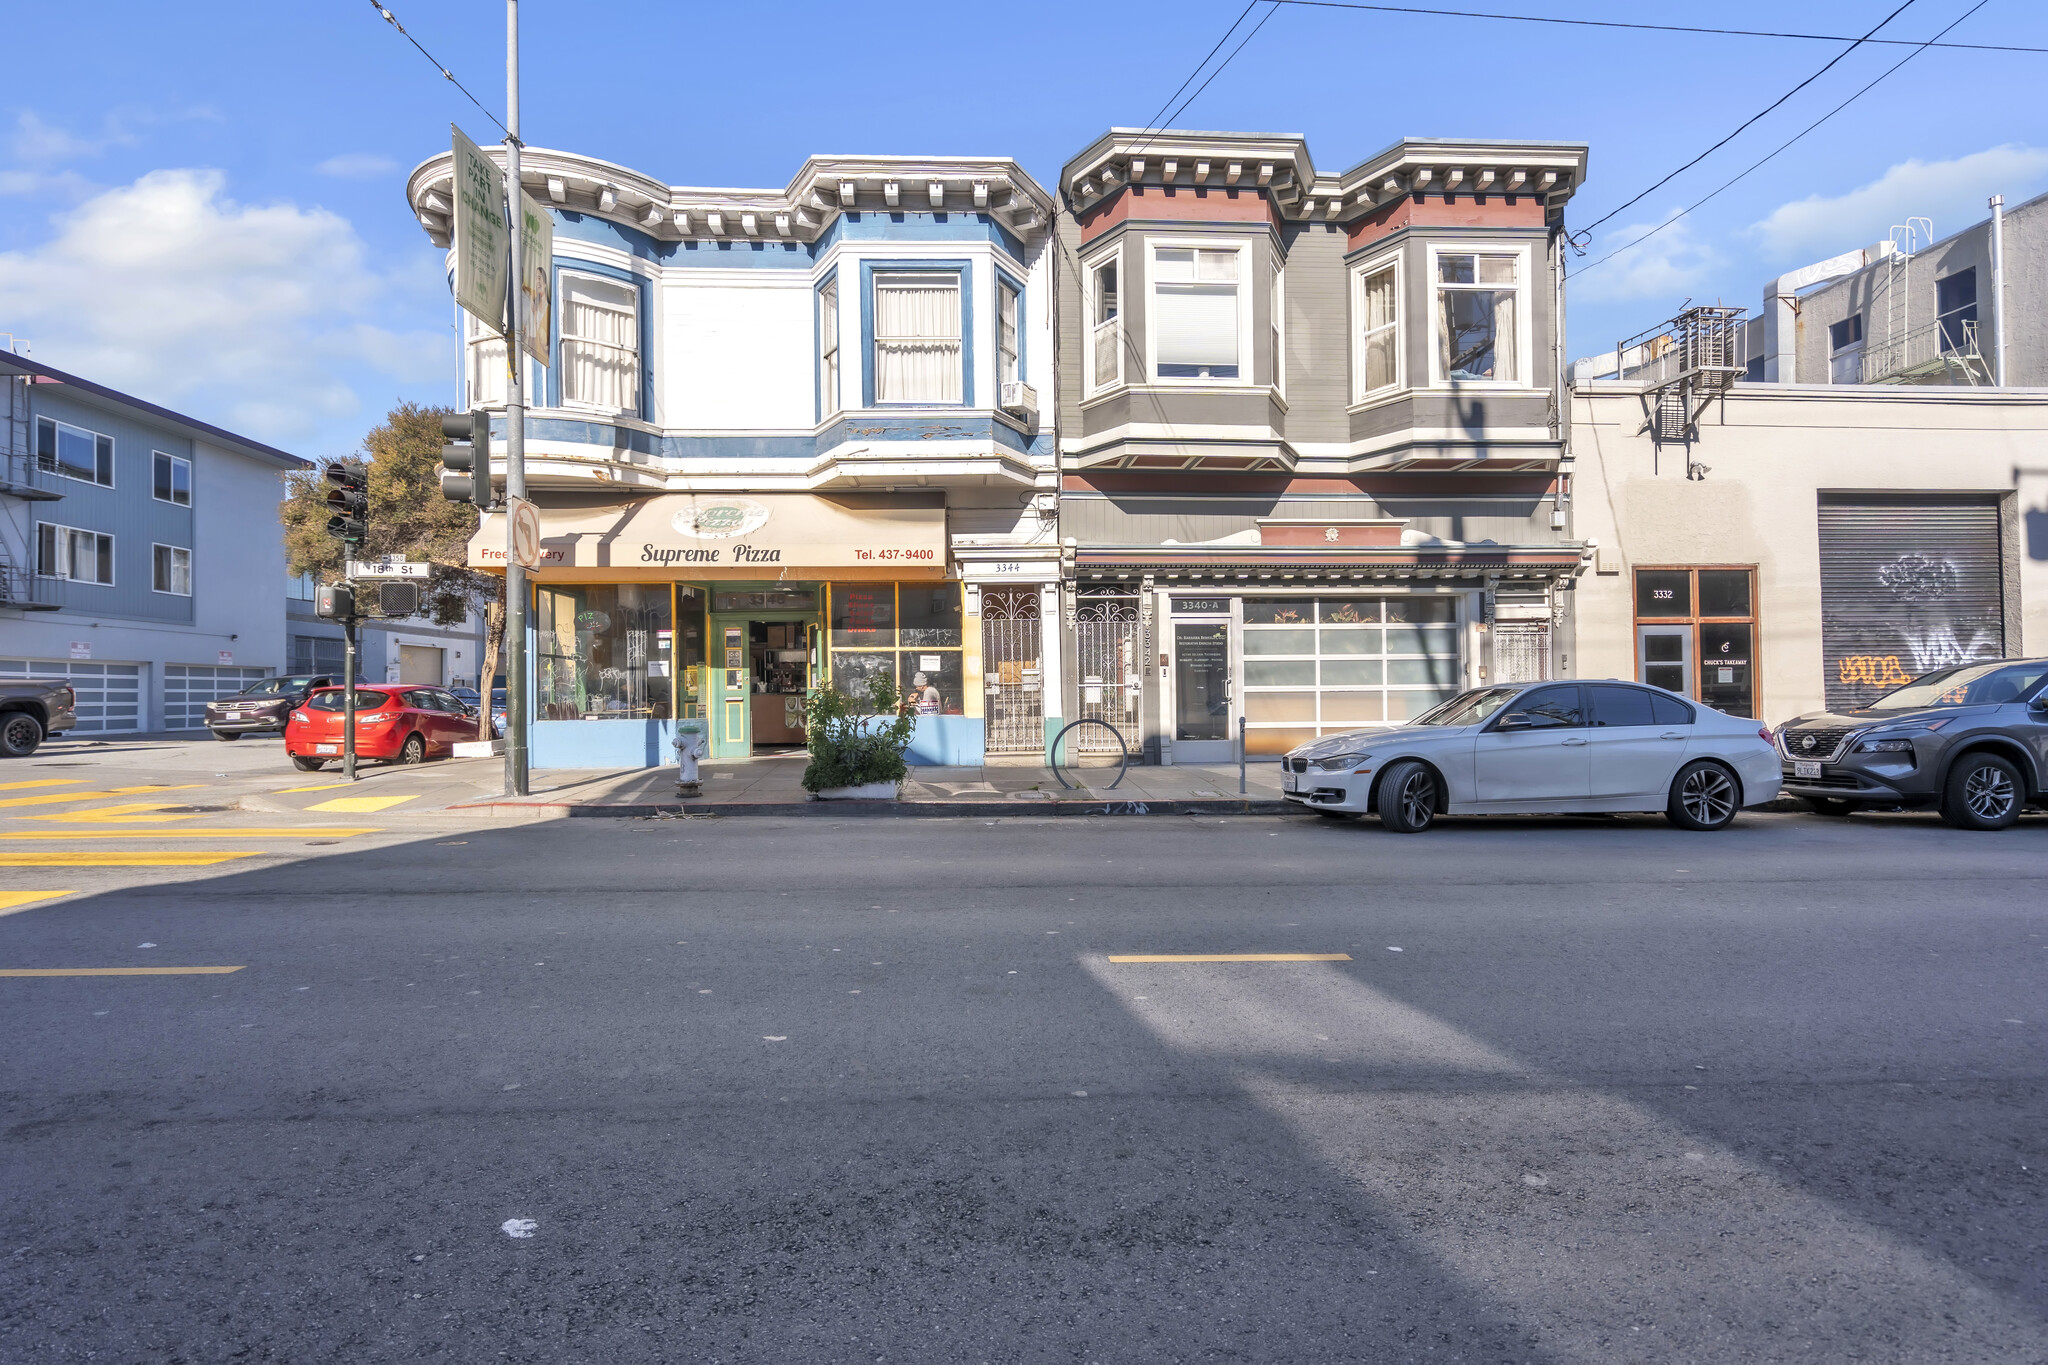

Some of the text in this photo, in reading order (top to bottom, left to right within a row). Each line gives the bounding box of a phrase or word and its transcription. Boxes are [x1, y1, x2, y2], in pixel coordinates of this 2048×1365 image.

[468, 152, 490, 180] TAKE
[468, 166, 491, 194] PART
[475, 187, 485, 204] IN
[462, 191, 502, 229] CHANGE
[481, 548, 508, 559] Free
[640, 543, 781, 567] Supreme Pizza
[855, 549, 934, 560] Tel. 437-9400
[373, 565, 413, 574] 18th St
[995, 563, 1020, 573] 3344
[1653, 590, 1673, 599] 3332
[1182, 601, 1219, 610] 3340-A
